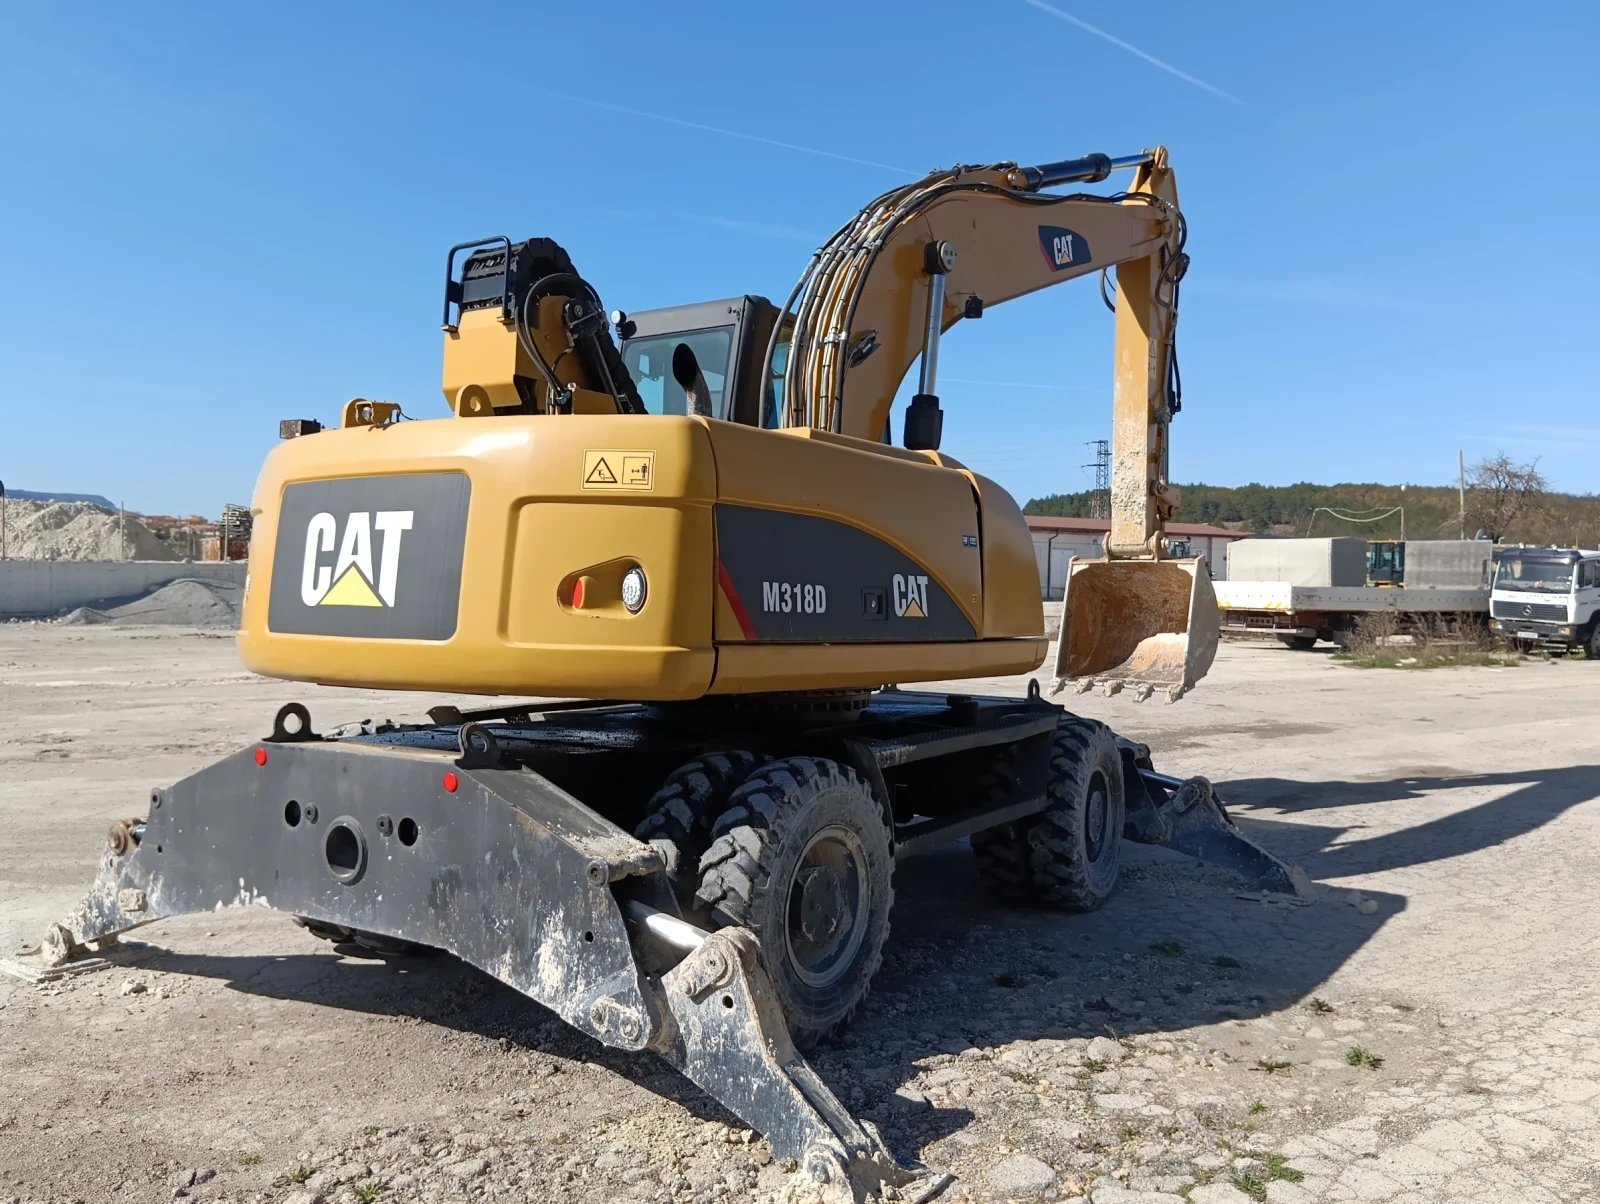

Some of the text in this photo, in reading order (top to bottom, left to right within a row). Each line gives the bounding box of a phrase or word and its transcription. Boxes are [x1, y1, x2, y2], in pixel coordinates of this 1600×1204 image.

[1053, 234, 1073, 265] CAT
[301, 510, 414, 607] CAT
[762, 581, 827, 614] M318D
[892, 573, 929, 618] CAT
